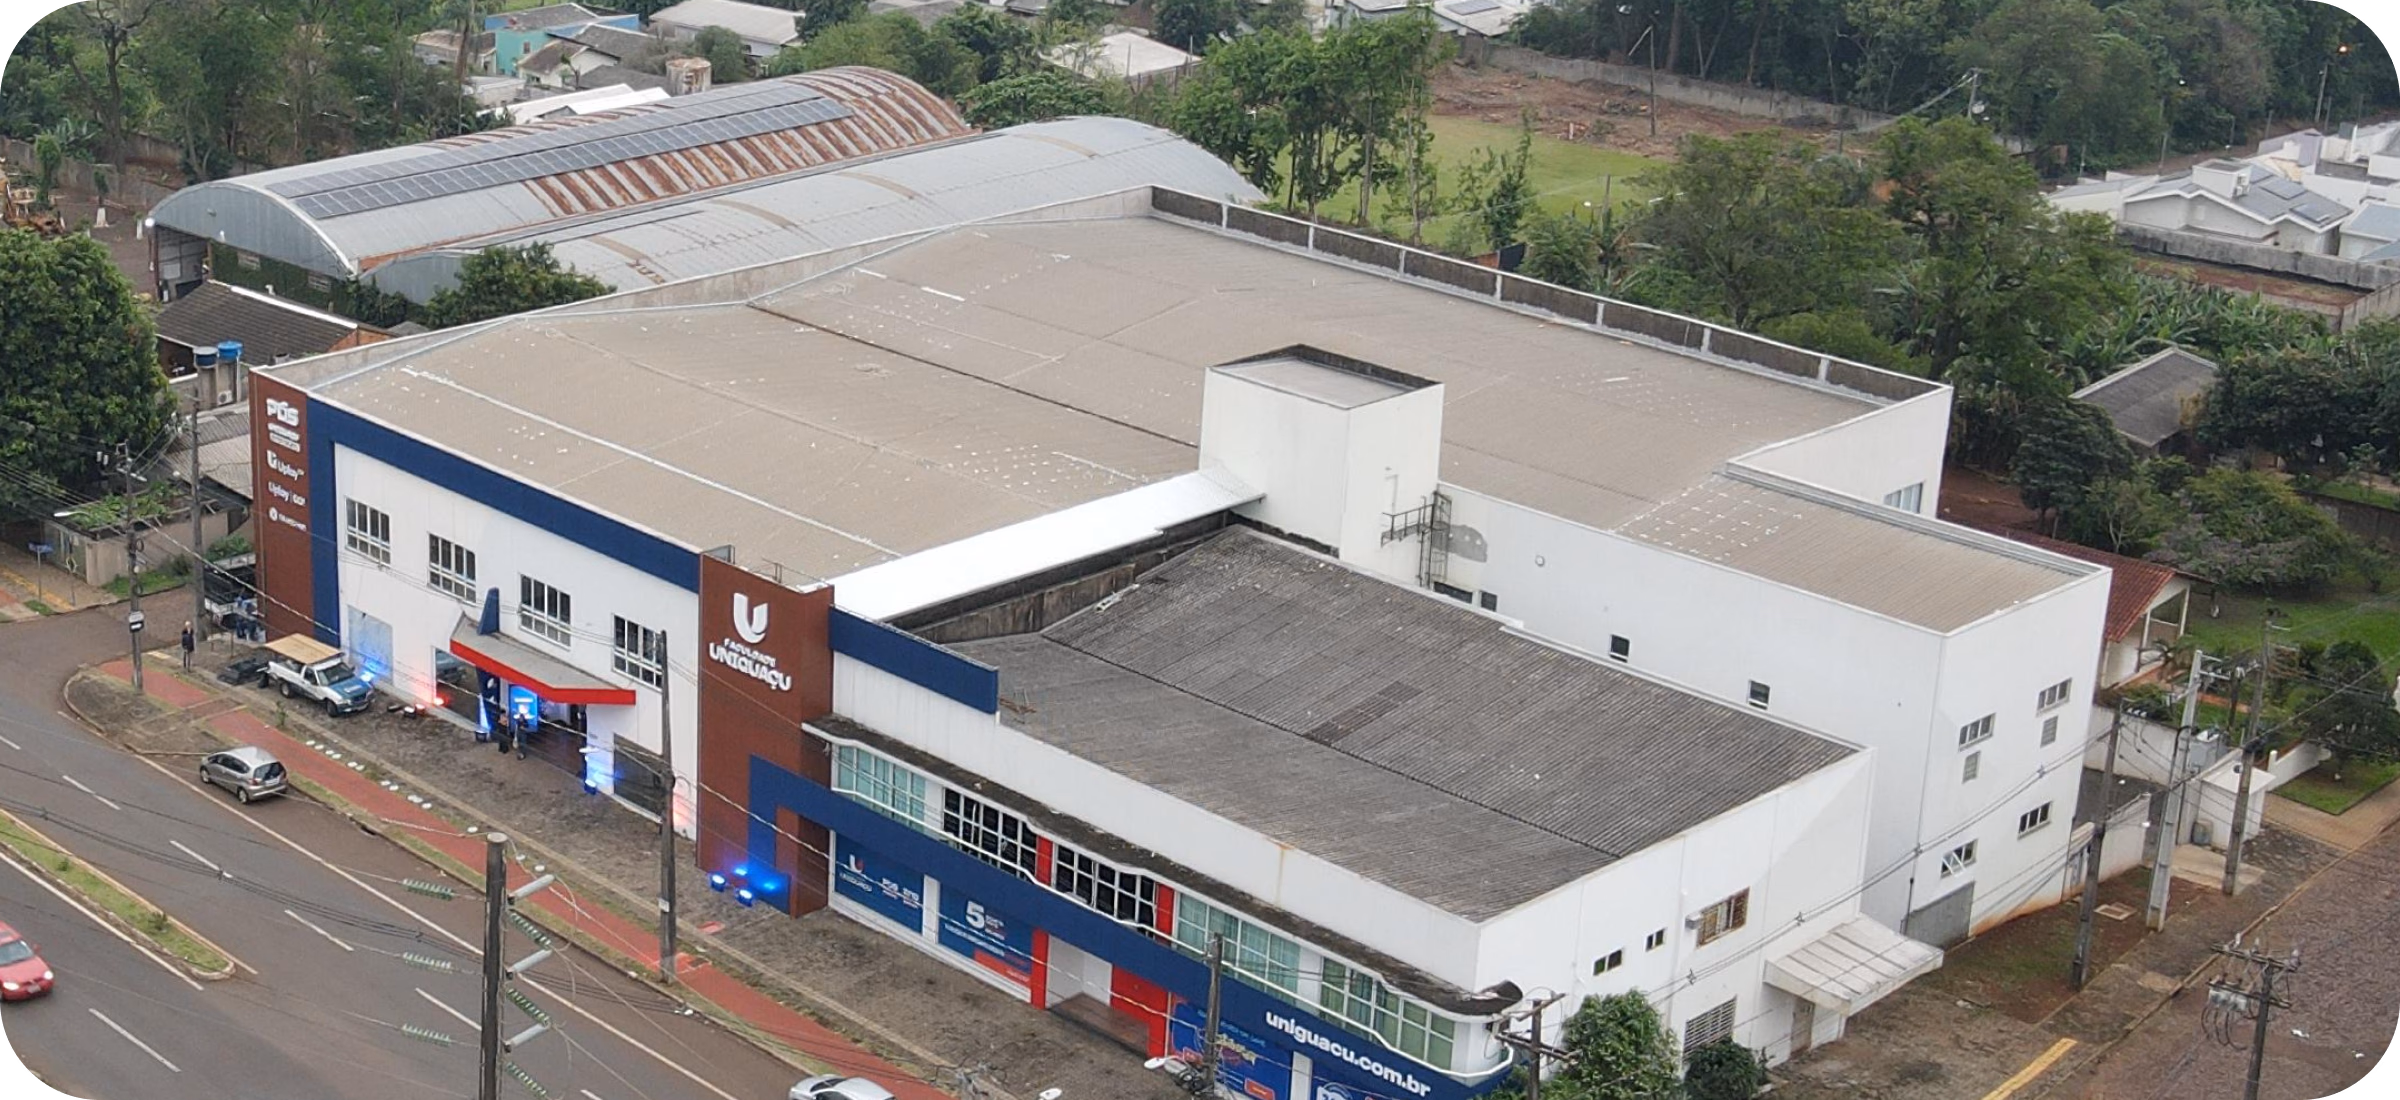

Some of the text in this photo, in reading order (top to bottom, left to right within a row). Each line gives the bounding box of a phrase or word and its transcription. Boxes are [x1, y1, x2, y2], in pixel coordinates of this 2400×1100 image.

[709, 642, 792, 691] UNIGUAÇU
[965, 900, 985, 929] 5
[1265, 1011, 1431, 1098] uniguacu.com.br
